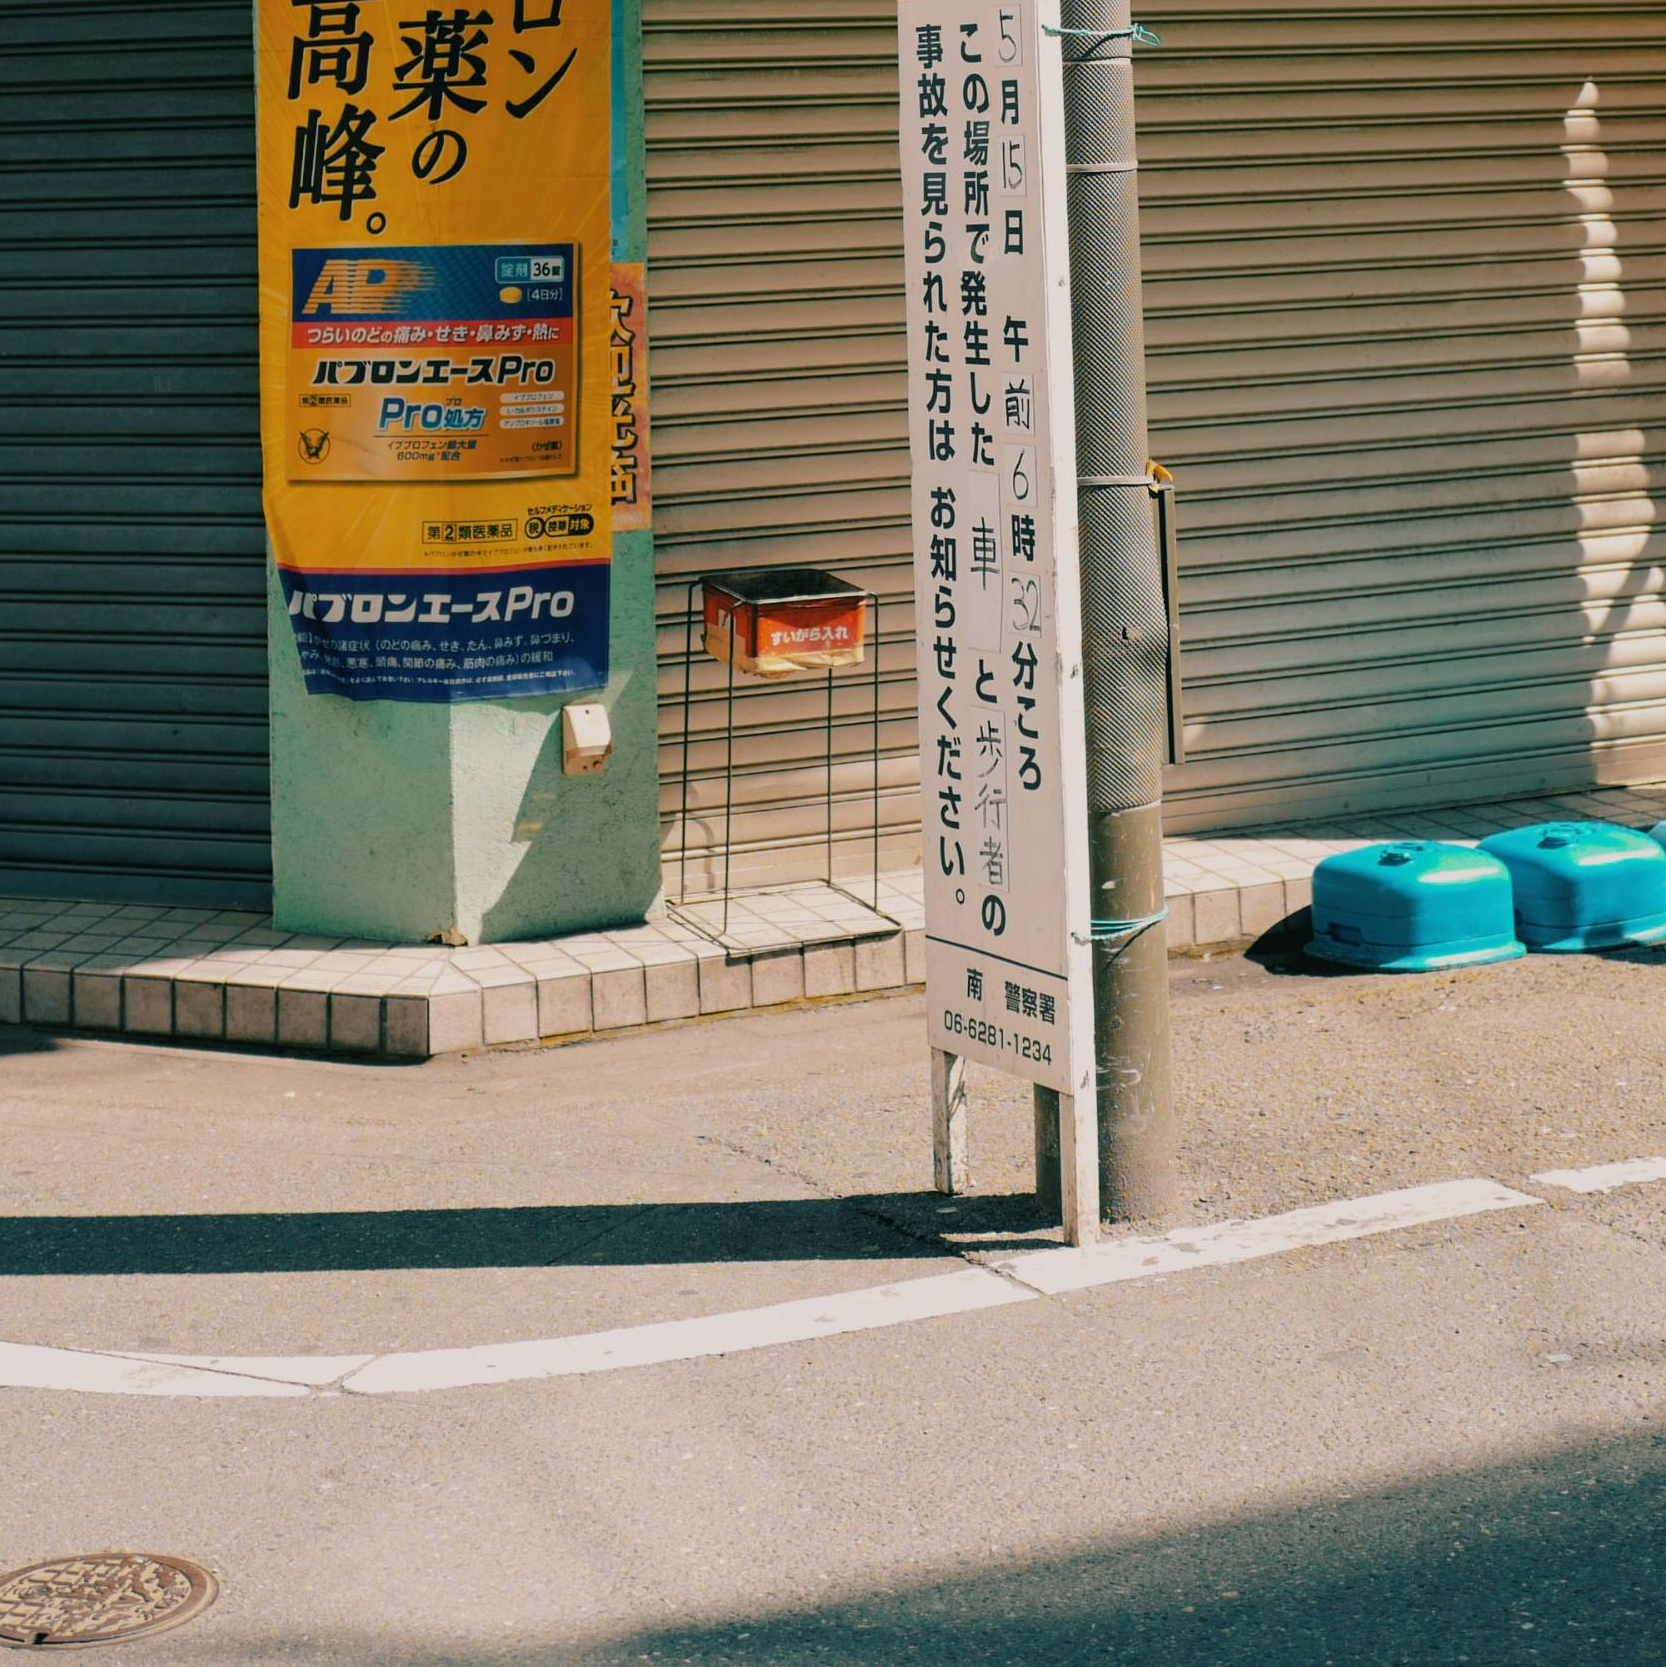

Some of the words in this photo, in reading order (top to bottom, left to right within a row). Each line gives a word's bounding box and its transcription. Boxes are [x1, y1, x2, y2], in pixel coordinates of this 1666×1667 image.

[959, 23, 995, 467] この場所で発生した
[312, 354, 555, 387] パブロンエースPro
[379, 397, 486, 431] Pro処方
[289, 585, 575, 624] パブロンエースPro
[770, 625, 849, 647] すいがら入れ
[967, 968, 983, 1002] 南
[1005, 980, 1056, 1026] 警察署
[943, 1009, 1053, 1066] 06-6281-1234
